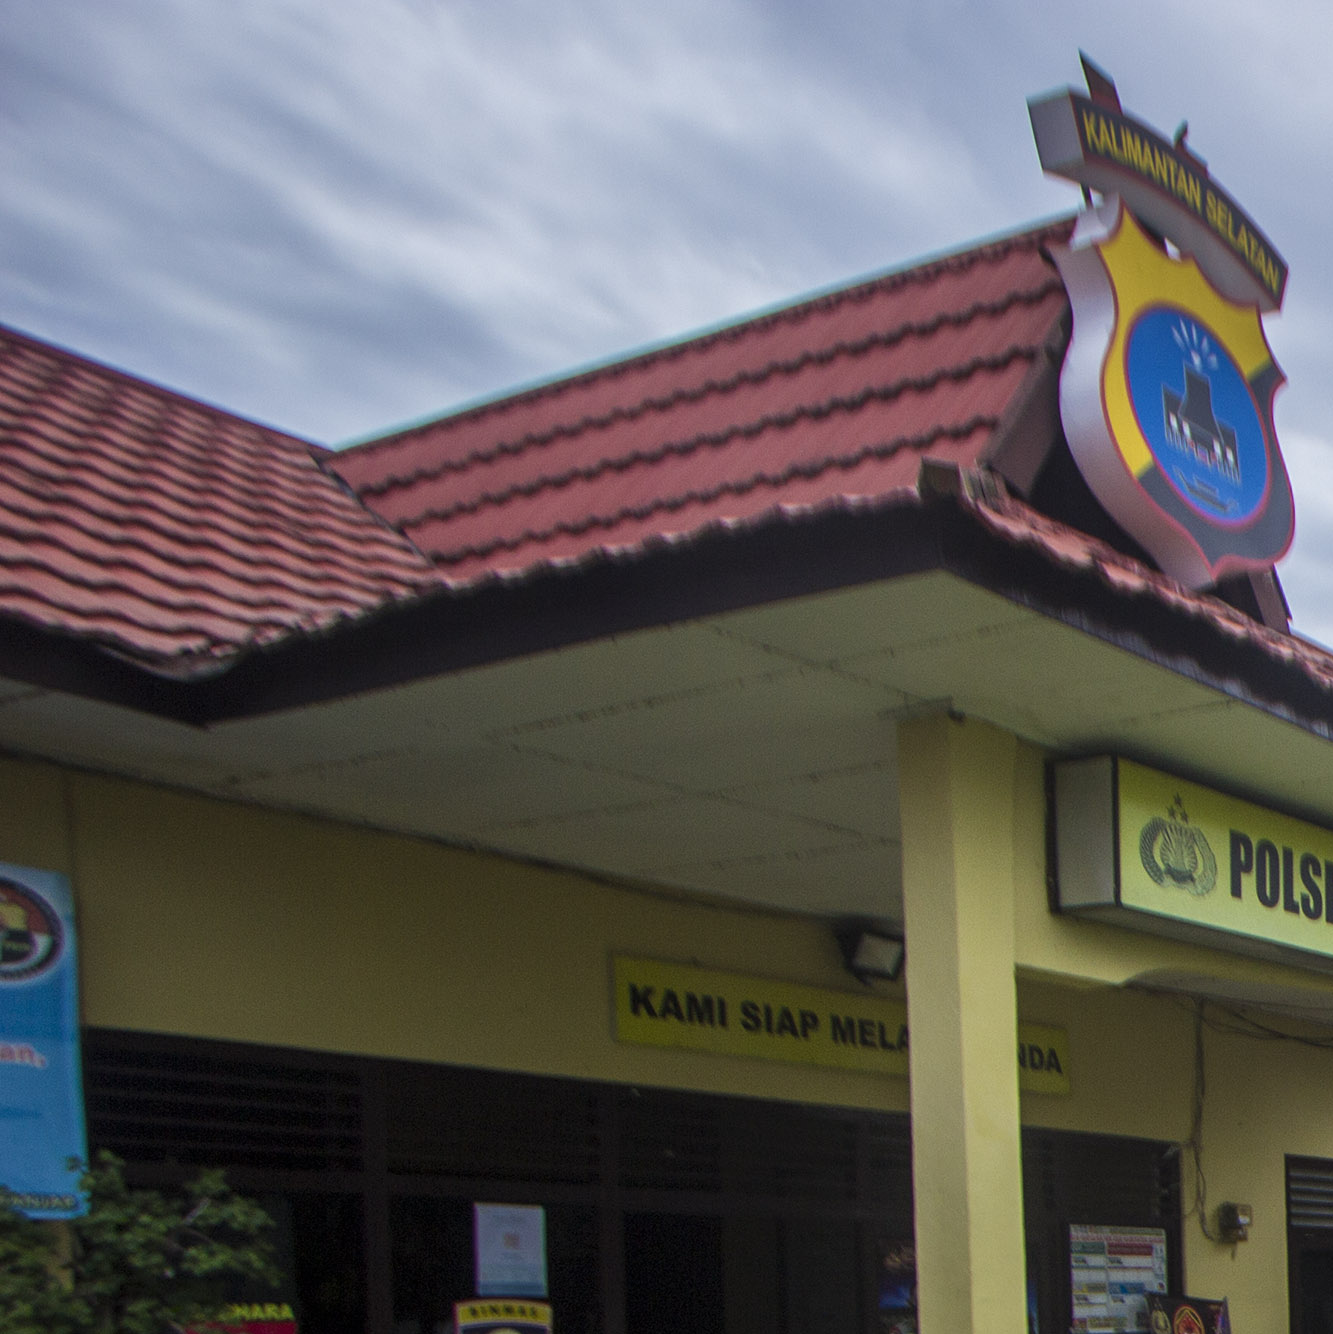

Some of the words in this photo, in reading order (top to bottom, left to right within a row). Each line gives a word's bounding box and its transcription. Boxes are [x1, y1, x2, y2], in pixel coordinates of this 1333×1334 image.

[1083, 108, 1201, 215] KALIMANTAN
[1205, 189, 1279, 296] SELATAN
[628, 983, 727, 1028] KAMI
[740, 1001, 820, 1040] SIAP
[831, 1014, 910, 1052] MELA
[1017, 1044, 1063, 1074] NDA
